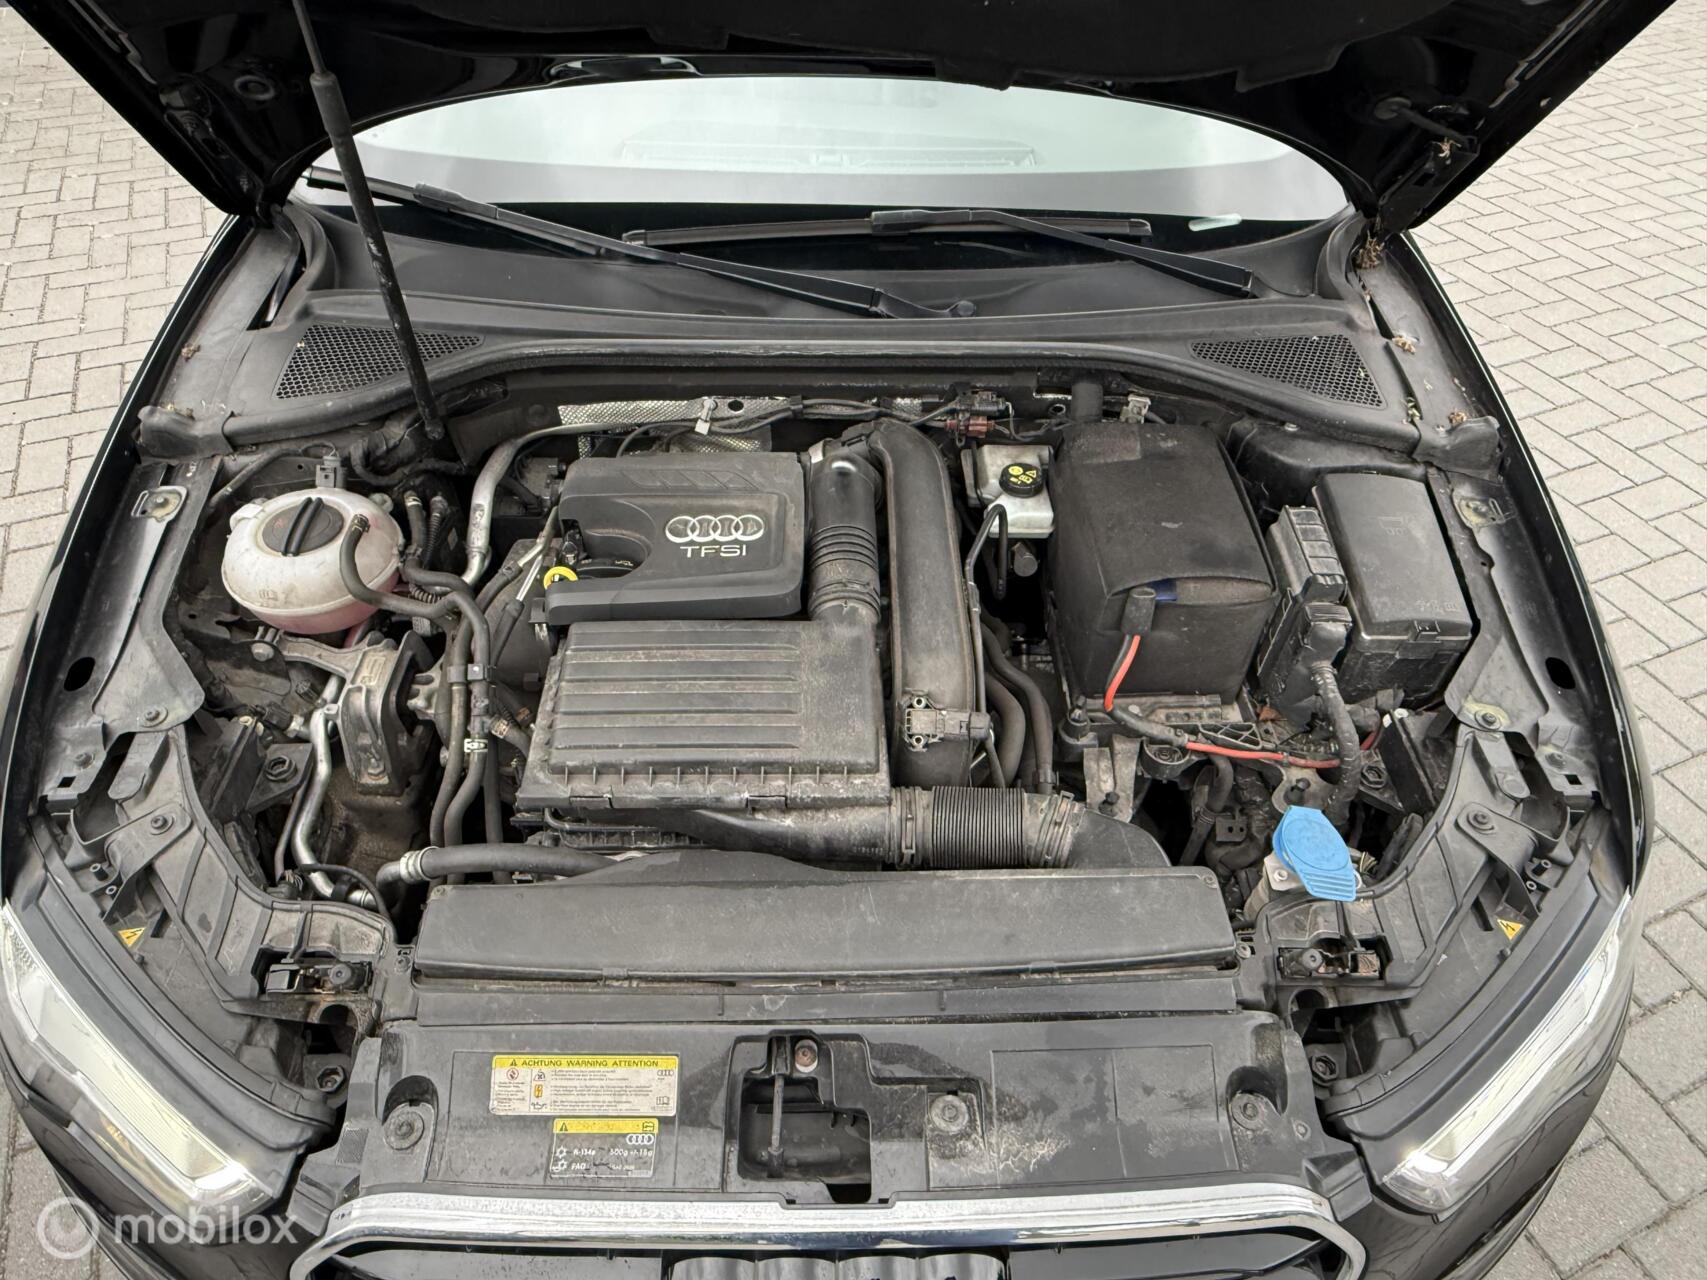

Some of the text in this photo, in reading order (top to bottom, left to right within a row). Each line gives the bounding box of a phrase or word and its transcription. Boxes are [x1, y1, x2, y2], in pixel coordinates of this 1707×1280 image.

[680, 544, 746, 558] TFSI
[521, 1059, 659, 1067] ACHTUNG WARNING ATTENTION
